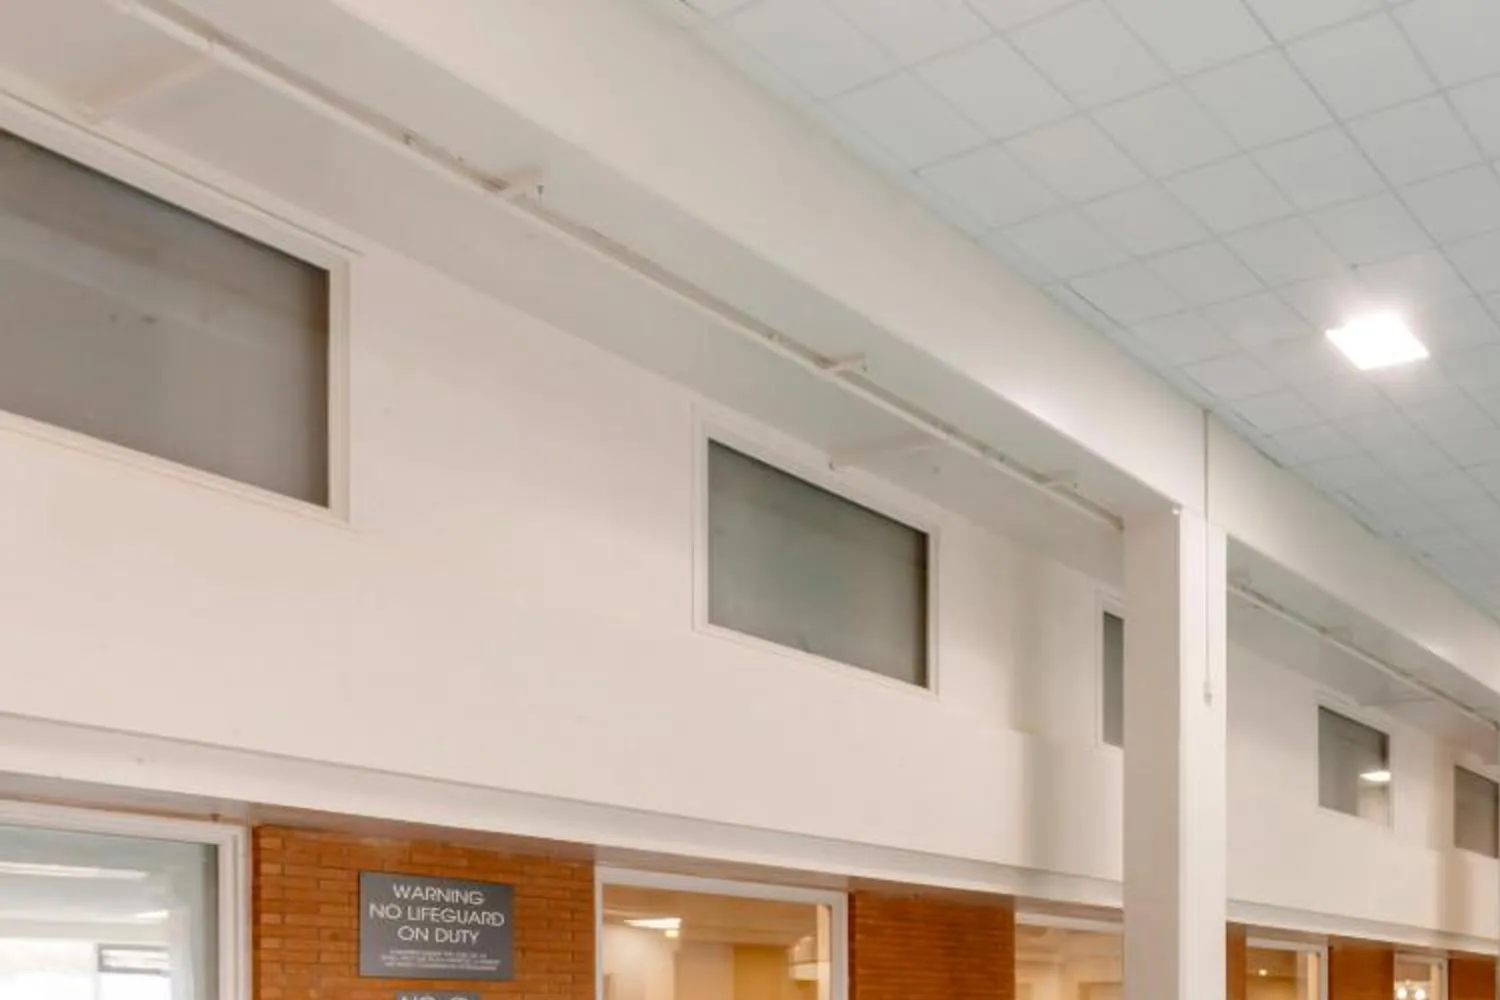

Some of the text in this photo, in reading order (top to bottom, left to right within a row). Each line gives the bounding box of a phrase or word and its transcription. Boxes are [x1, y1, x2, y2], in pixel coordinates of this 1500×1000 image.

[392, 883, 485, 906] WARNING
[369, 903, 505, 927] NO LIFEGUARD
[397, 925, 480, 946] ON DUTY
